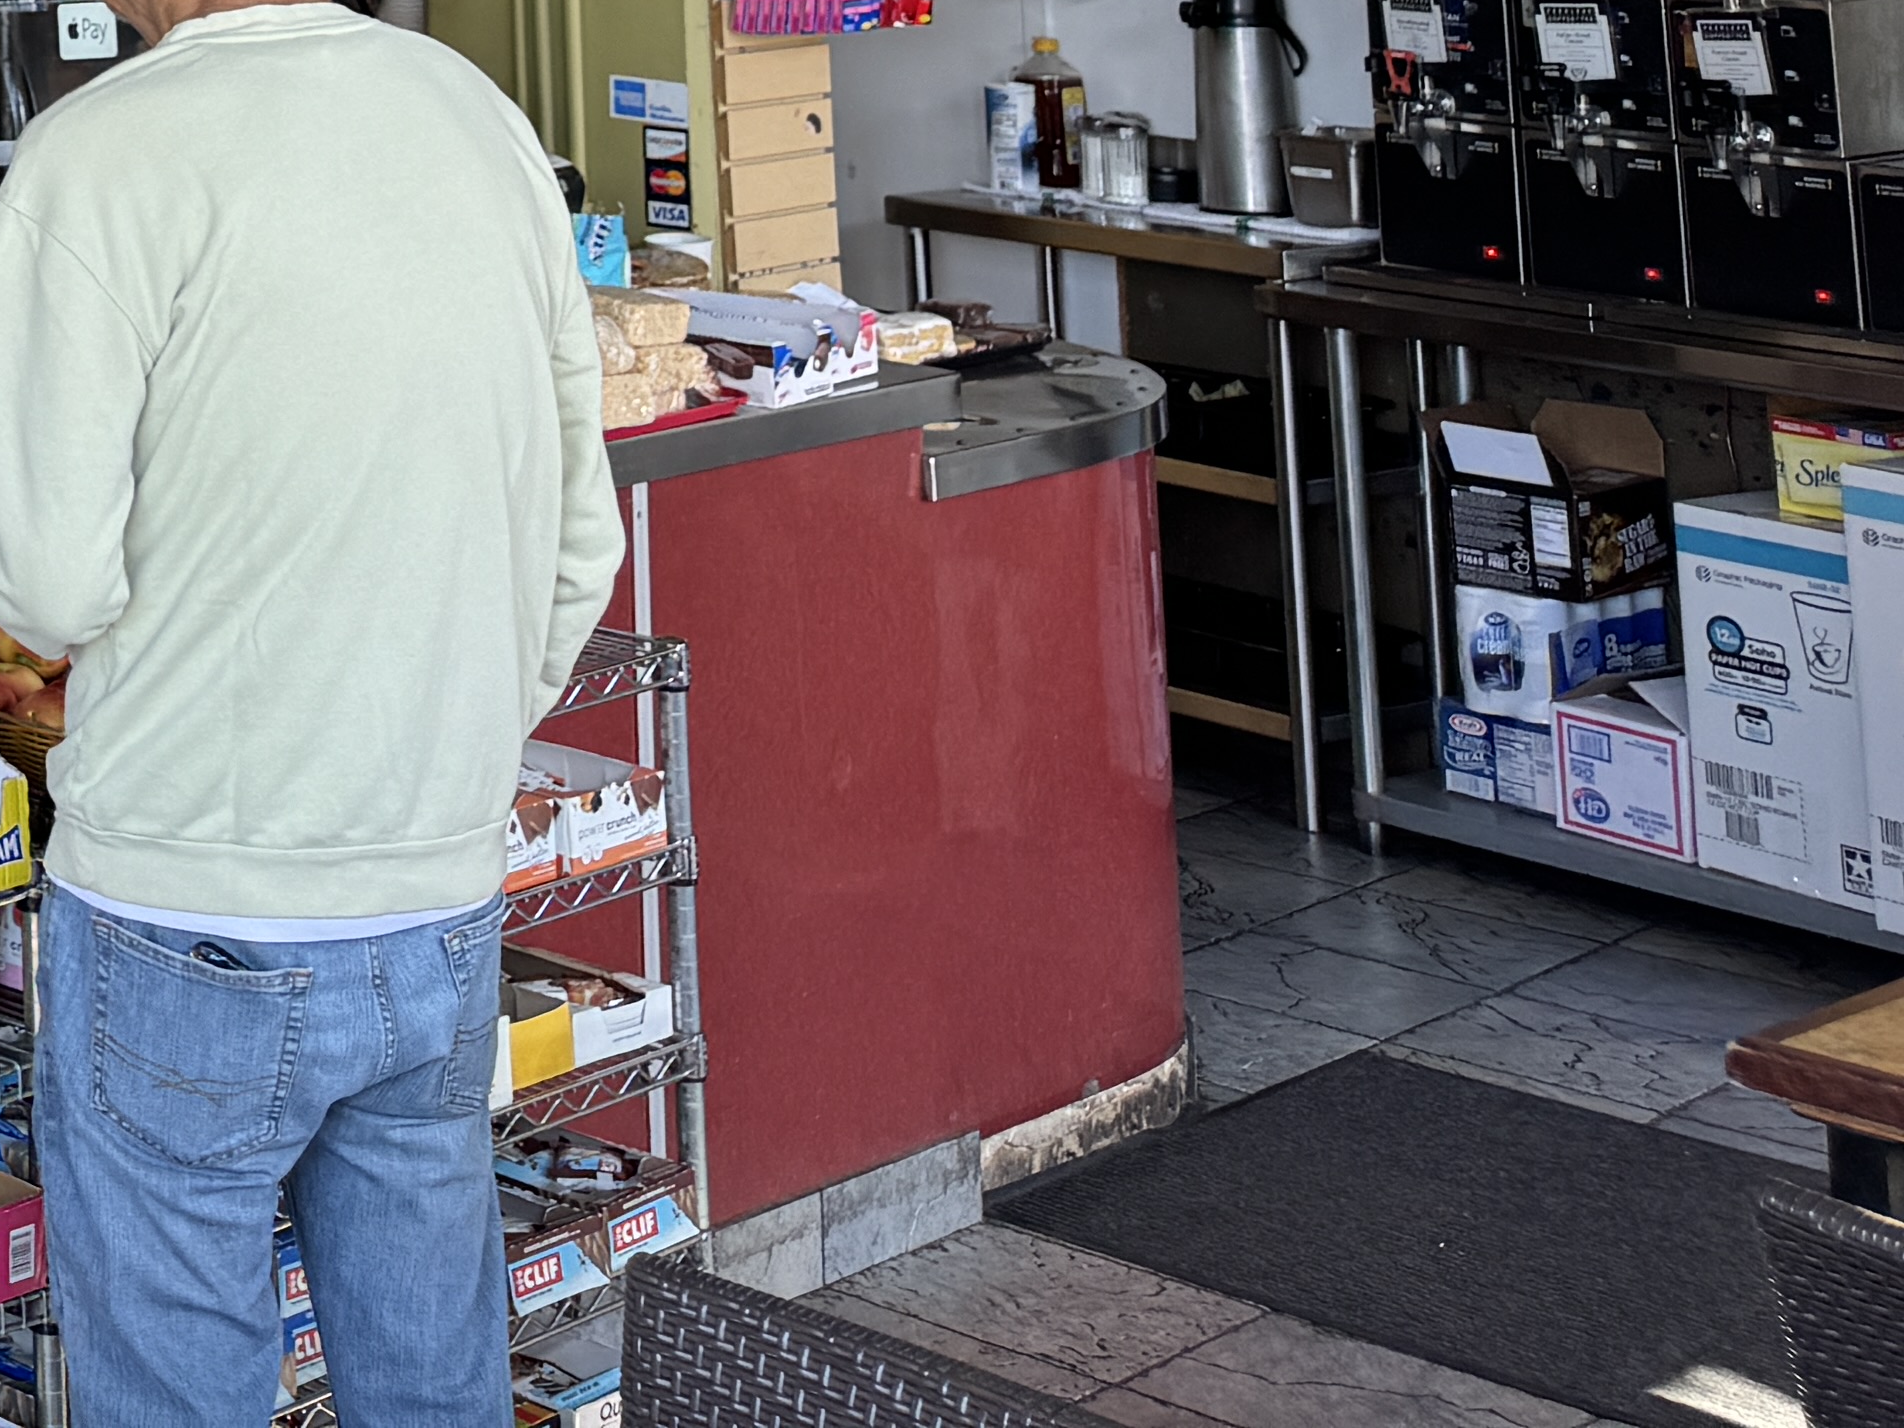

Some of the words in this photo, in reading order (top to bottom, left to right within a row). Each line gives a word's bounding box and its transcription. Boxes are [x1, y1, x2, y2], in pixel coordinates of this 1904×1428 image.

[82, 18, 108, 44] Pay
[653, 207, 686, 221] VISA
[623, 1212, 656, 1244] CLIF
[523, 1257, 559, 1290] CLIF
